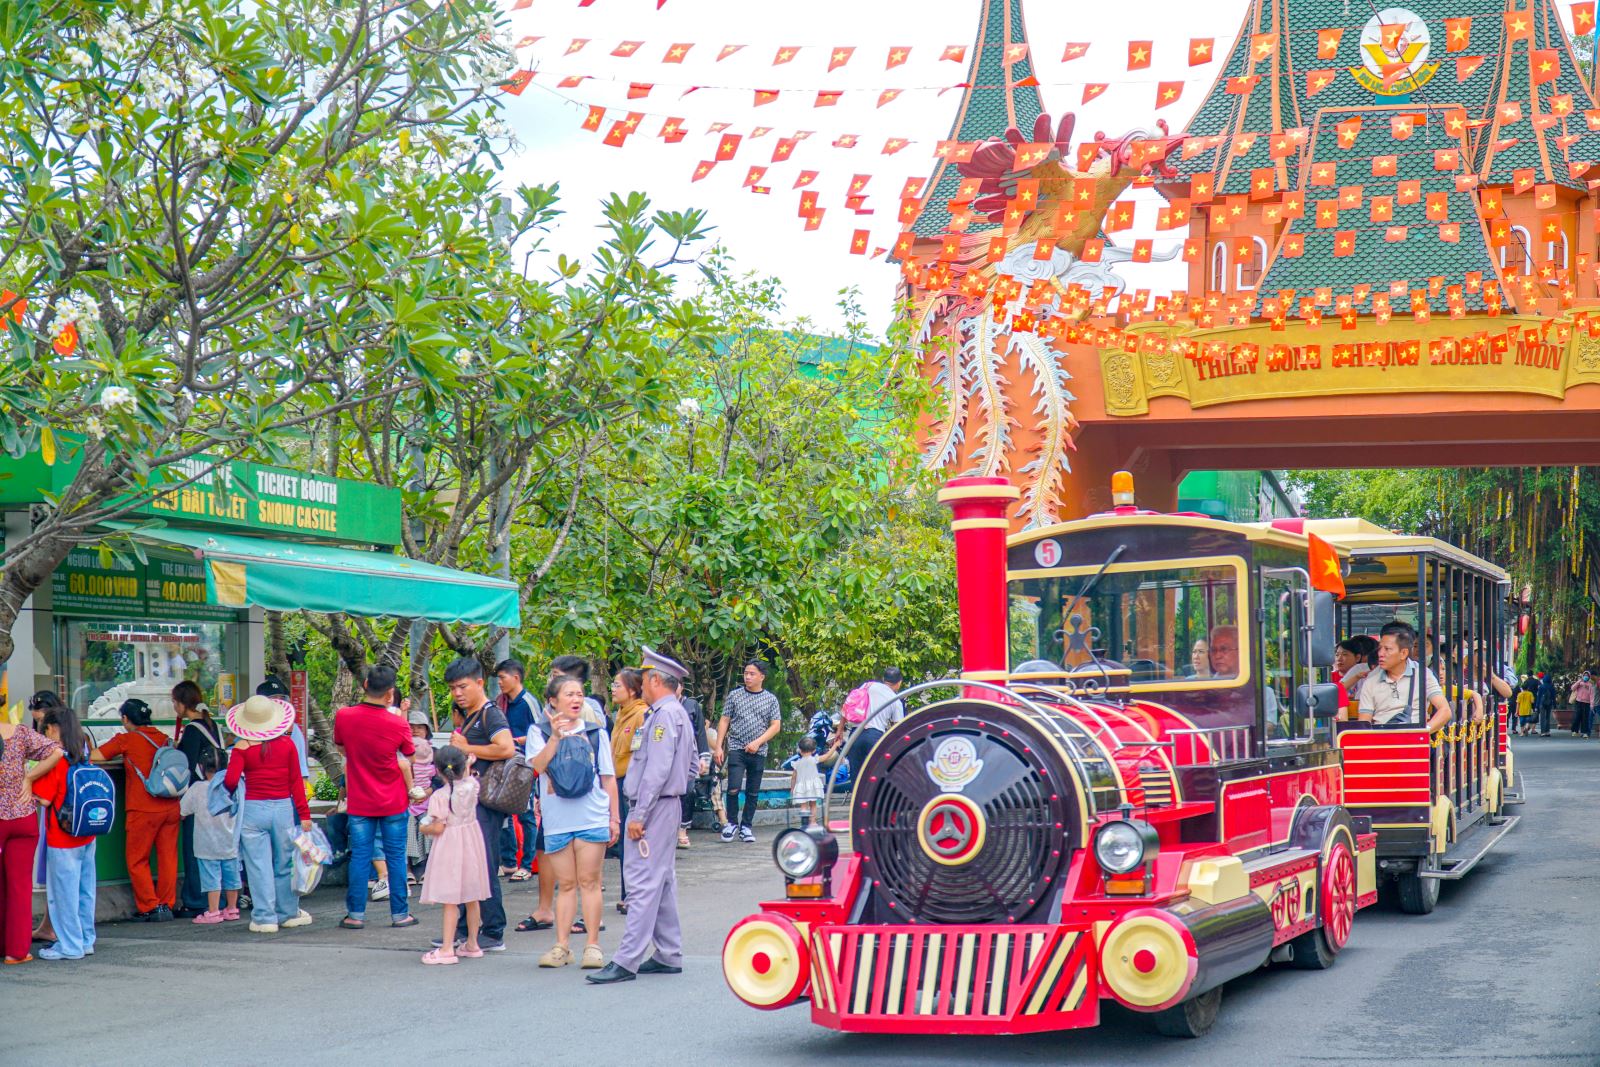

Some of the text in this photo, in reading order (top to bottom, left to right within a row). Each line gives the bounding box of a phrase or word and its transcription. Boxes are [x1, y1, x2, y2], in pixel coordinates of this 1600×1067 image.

[1267, 346, 1321, 373] ON
[1430, 338, 1503, 366] ONG
[181, 486, 205, 513] ĐÀI
[257, 470, 337, 504] TICKET BOOTH
[258, 499, 337, 533] SNOW CASTLE
[1042, 542, 1055, 565] 5
